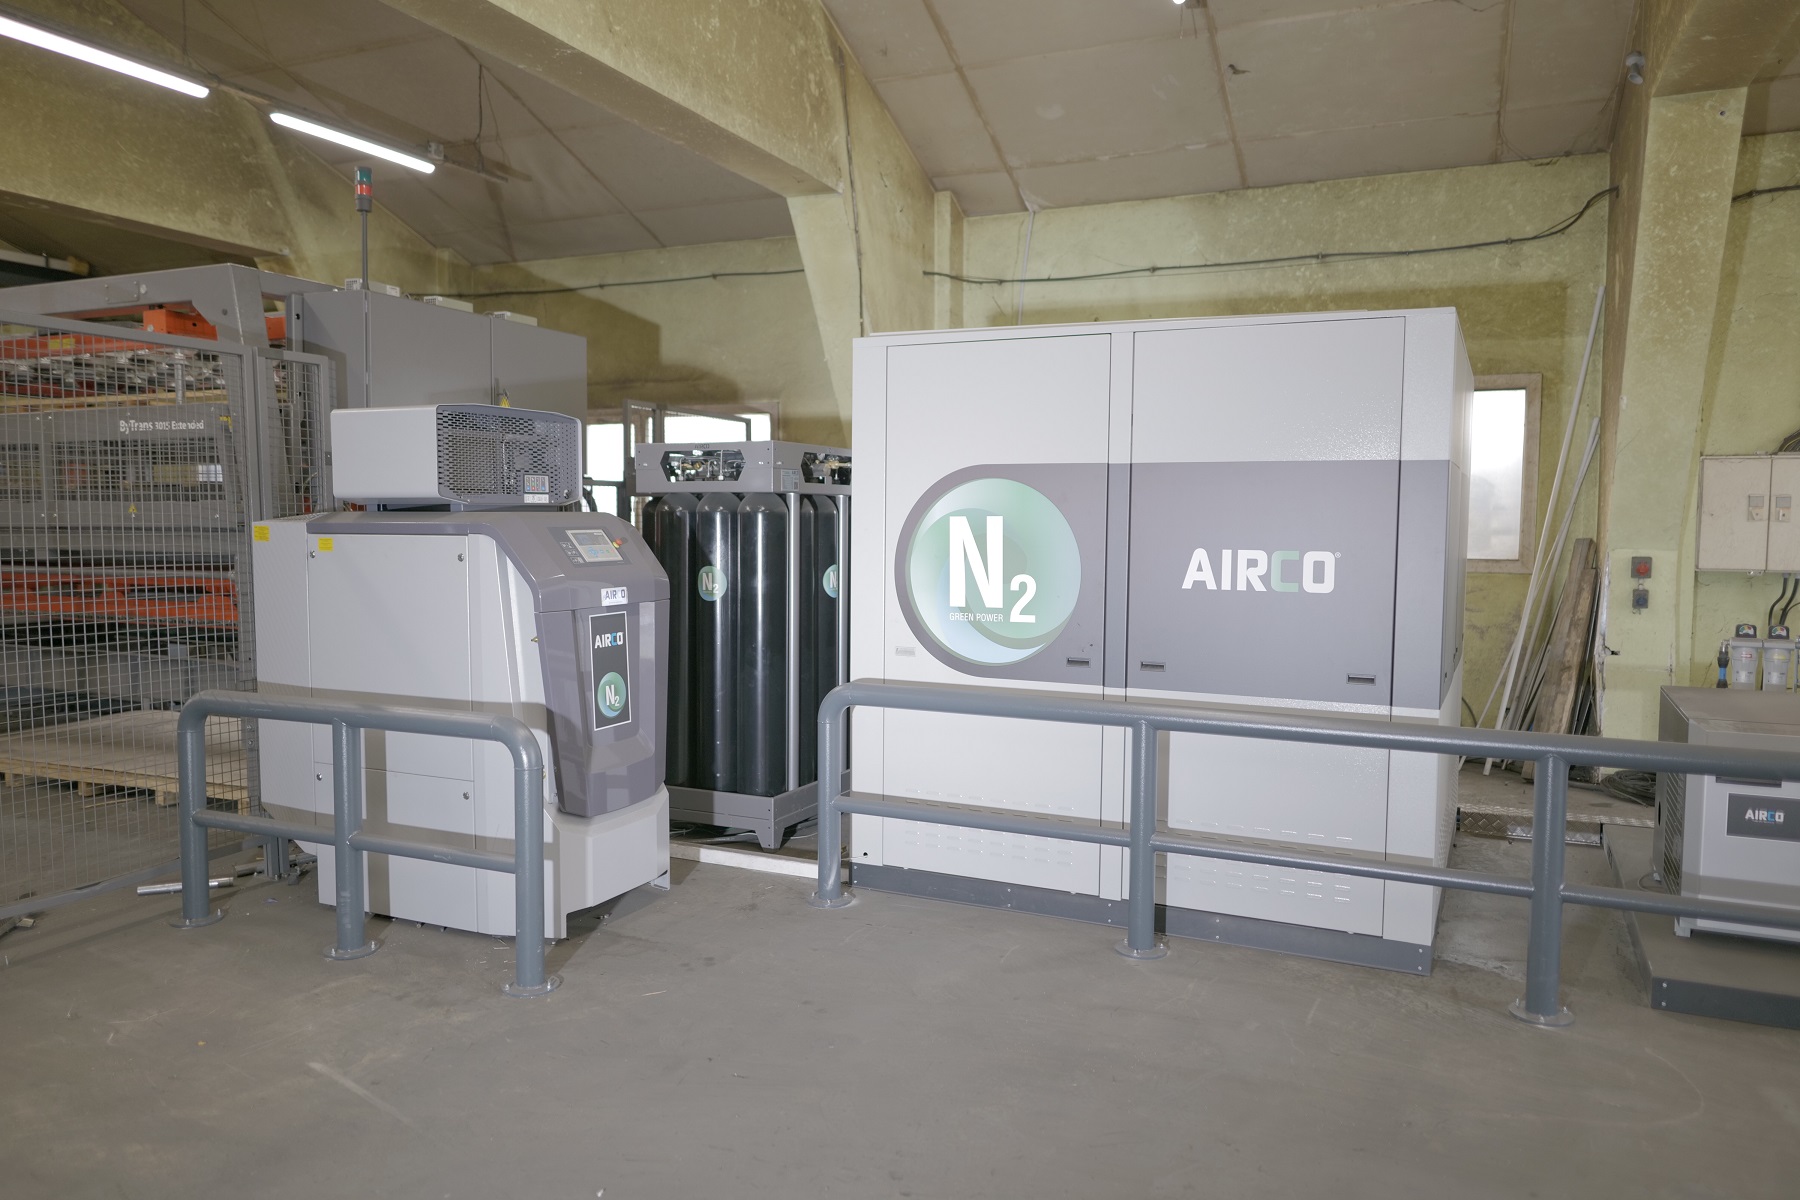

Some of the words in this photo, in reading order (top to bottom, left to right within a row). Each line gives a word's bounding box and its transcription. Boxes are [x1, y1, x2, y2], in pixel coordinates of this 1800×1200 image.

[949, 515, 1037, 623] N2
[949, 612, 974, 621] GREEN
[976, 613, 1004, 622] POWER
[594, 632, 624, 649] AIRCO
[1744, 808, 1785, 823] AIRCO
